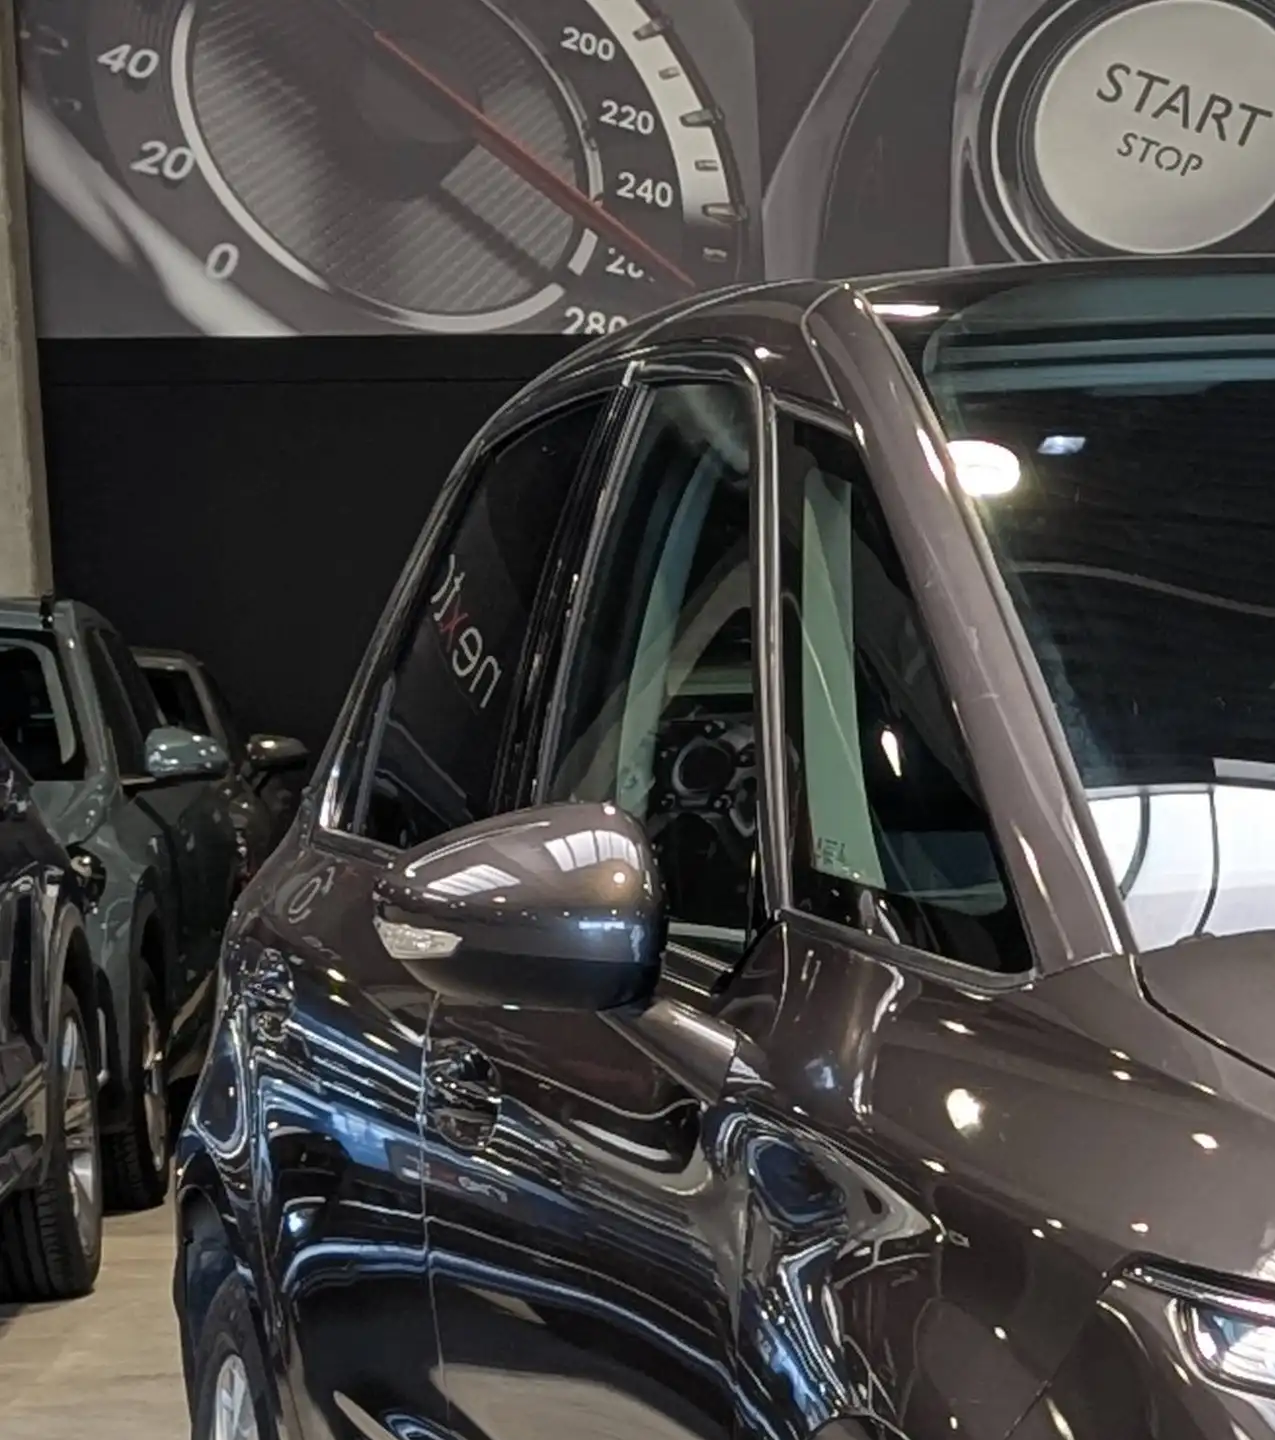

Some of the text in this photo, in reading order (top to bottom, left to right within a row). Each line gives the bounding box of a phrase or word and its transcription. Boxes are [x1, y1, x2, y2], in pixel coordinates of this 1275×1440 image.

[97, 43, 160, 79] 40
[560, 26, 616, 62] 200
[599, 99, 655, 136] 220
[1096, 62, 1274, 147] START
[129, 140, 195, 181] 20
[1116, 132, 1204, 177] STOP
[615, 171, 675, 209] 240
[204, 242, 240, 280] 0
